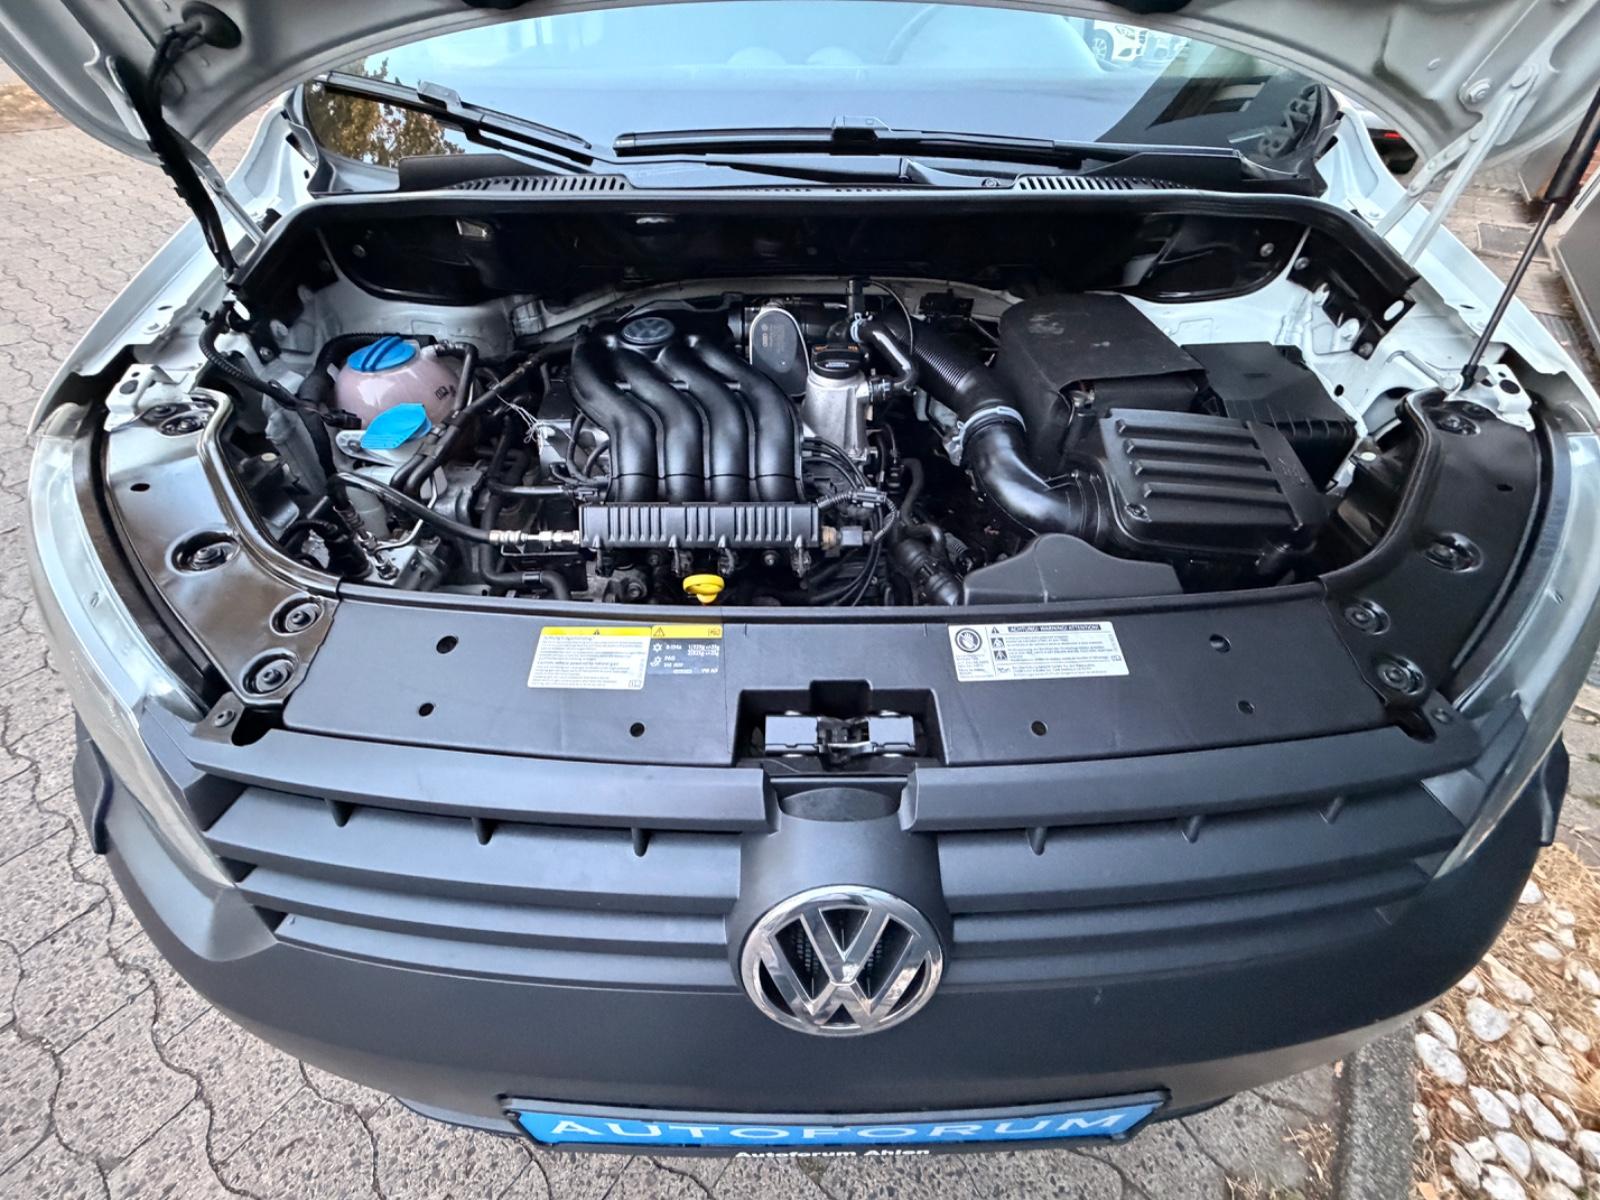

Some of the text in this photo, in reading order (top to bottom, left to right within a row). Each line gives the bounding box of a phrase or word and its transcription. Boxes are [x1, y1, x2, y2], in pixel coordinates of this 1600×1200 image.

[743, 887, 941, 1034] VW
[551, 1114, 1127, 1138] AUTOFORUM
[863, 1149, 930, 1157] Ahlen
